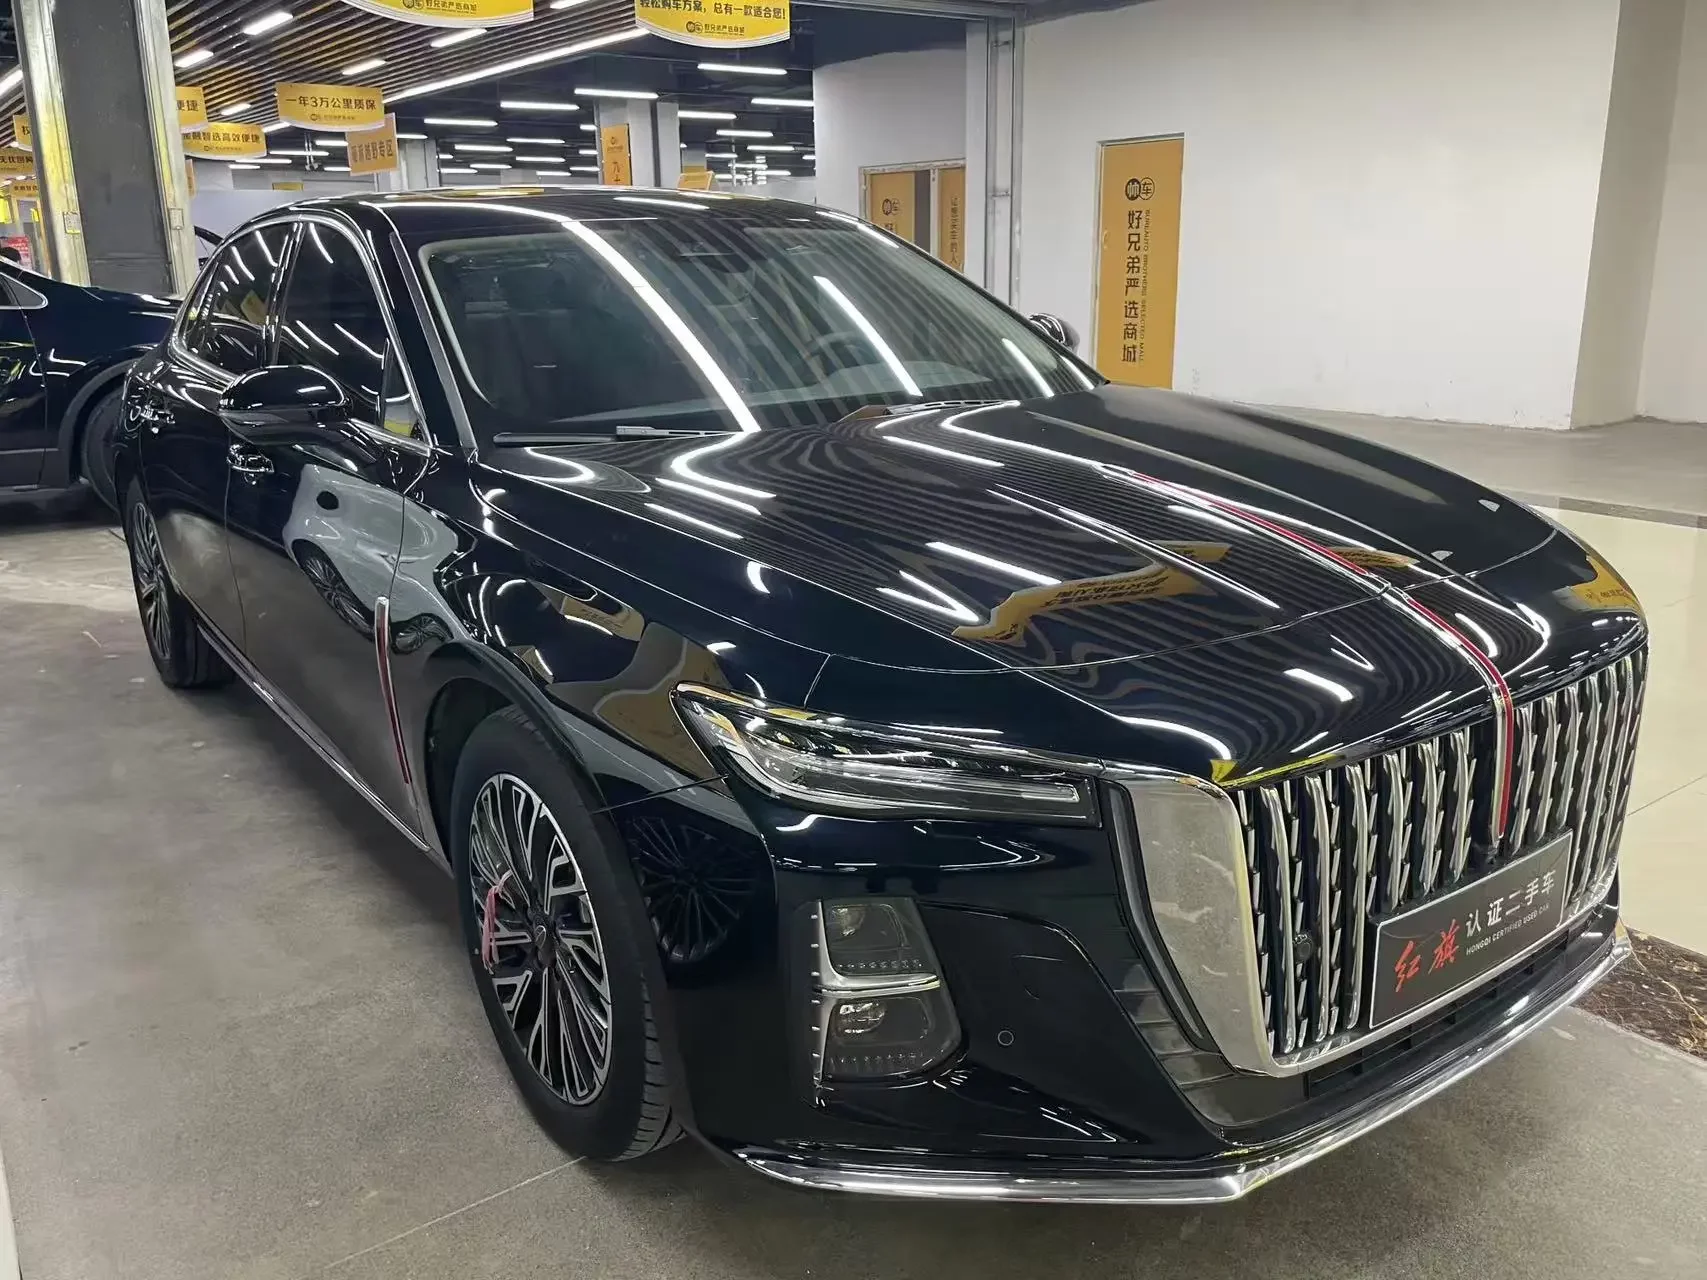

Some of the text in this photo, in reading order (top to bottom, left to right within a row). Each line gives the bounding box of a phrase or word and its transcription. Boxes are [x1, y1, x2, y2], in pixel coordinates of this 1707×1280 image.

[286, 96, 377, 111] 一年3万公里质保
[1121, 210, 1143, 363] 好兄弟严选商城
[1394, 869, 1557, 993] 红旗 认证二手车
[1466, 936, 1492, 956] HONGQI
[1492, 919, 1522, 942] CERTIFIED
